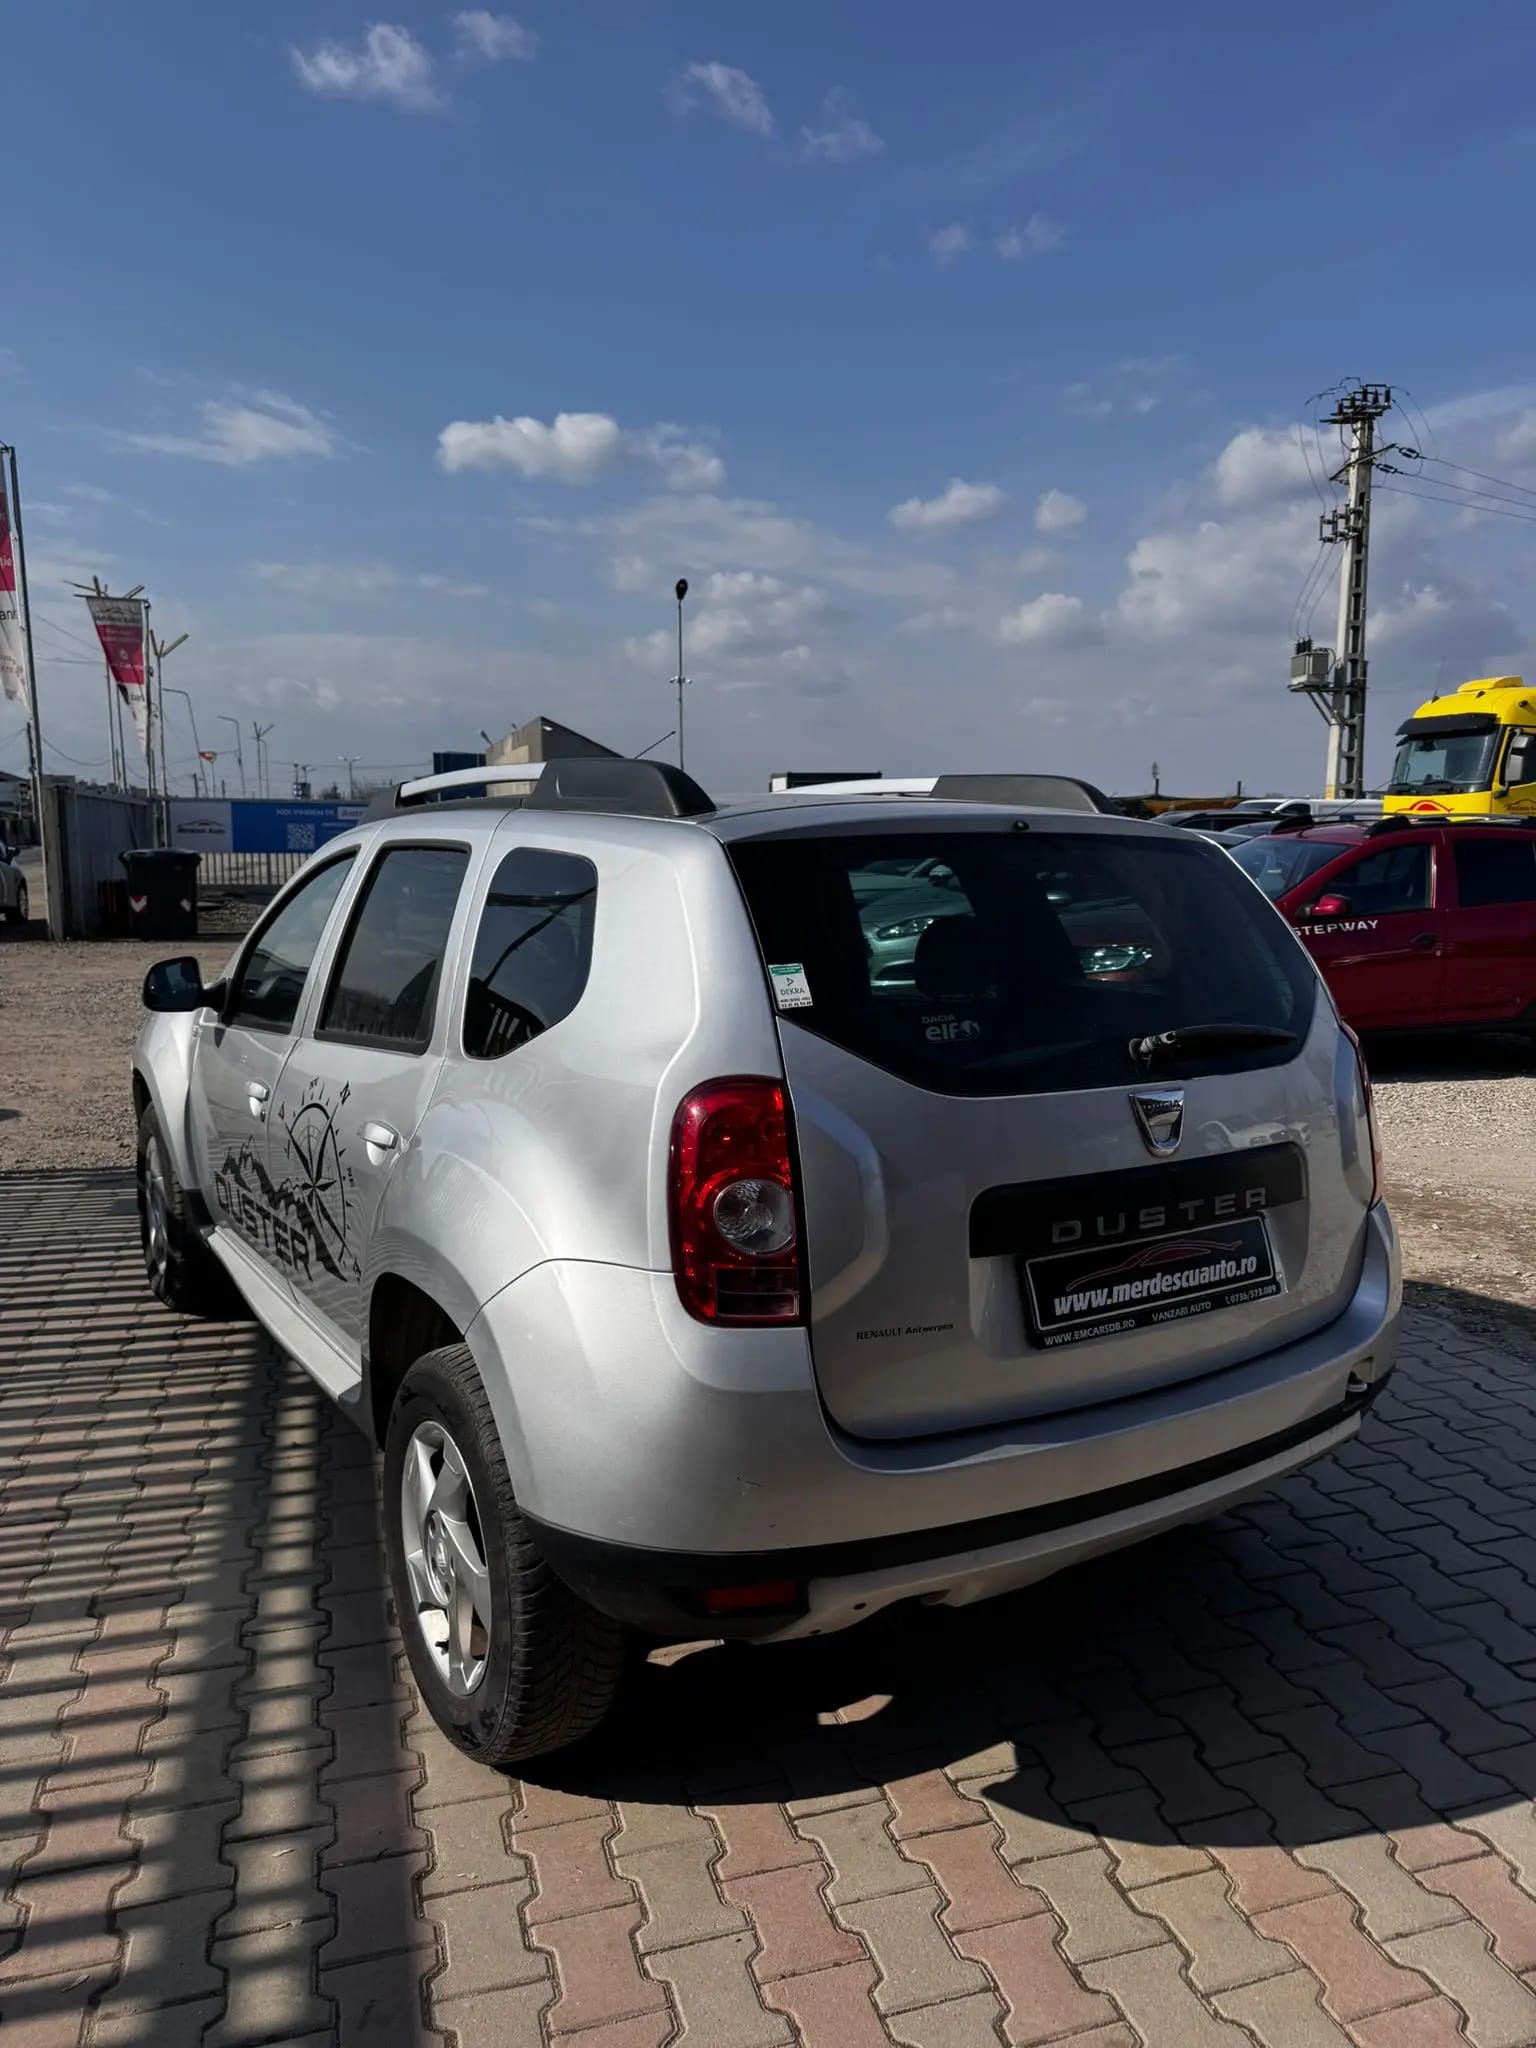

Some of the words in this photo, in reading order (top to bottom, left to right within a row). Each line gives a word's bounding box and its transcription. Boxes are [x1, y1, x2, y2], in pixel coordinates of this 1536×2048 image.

[780, 986, 806, 996] DEKRA
[921, 1013, 957, 1024] DACIA
[925, 1022, 959, 1041] elf
[1051, 1187, 1267, 1244] DUSTER
[213, 1170, 314, 1283] DUSTER
[1053, 1255, 1258, 1317] www.merdescuauto.ro
[1151, 1305, 1189, 1323] VANZARI
[1190, 1300, 1212, 1314] AUTO
[855, 1327, 903, 1341] RENAULT
[904, 1322, 955, 1335] Antwerpen
